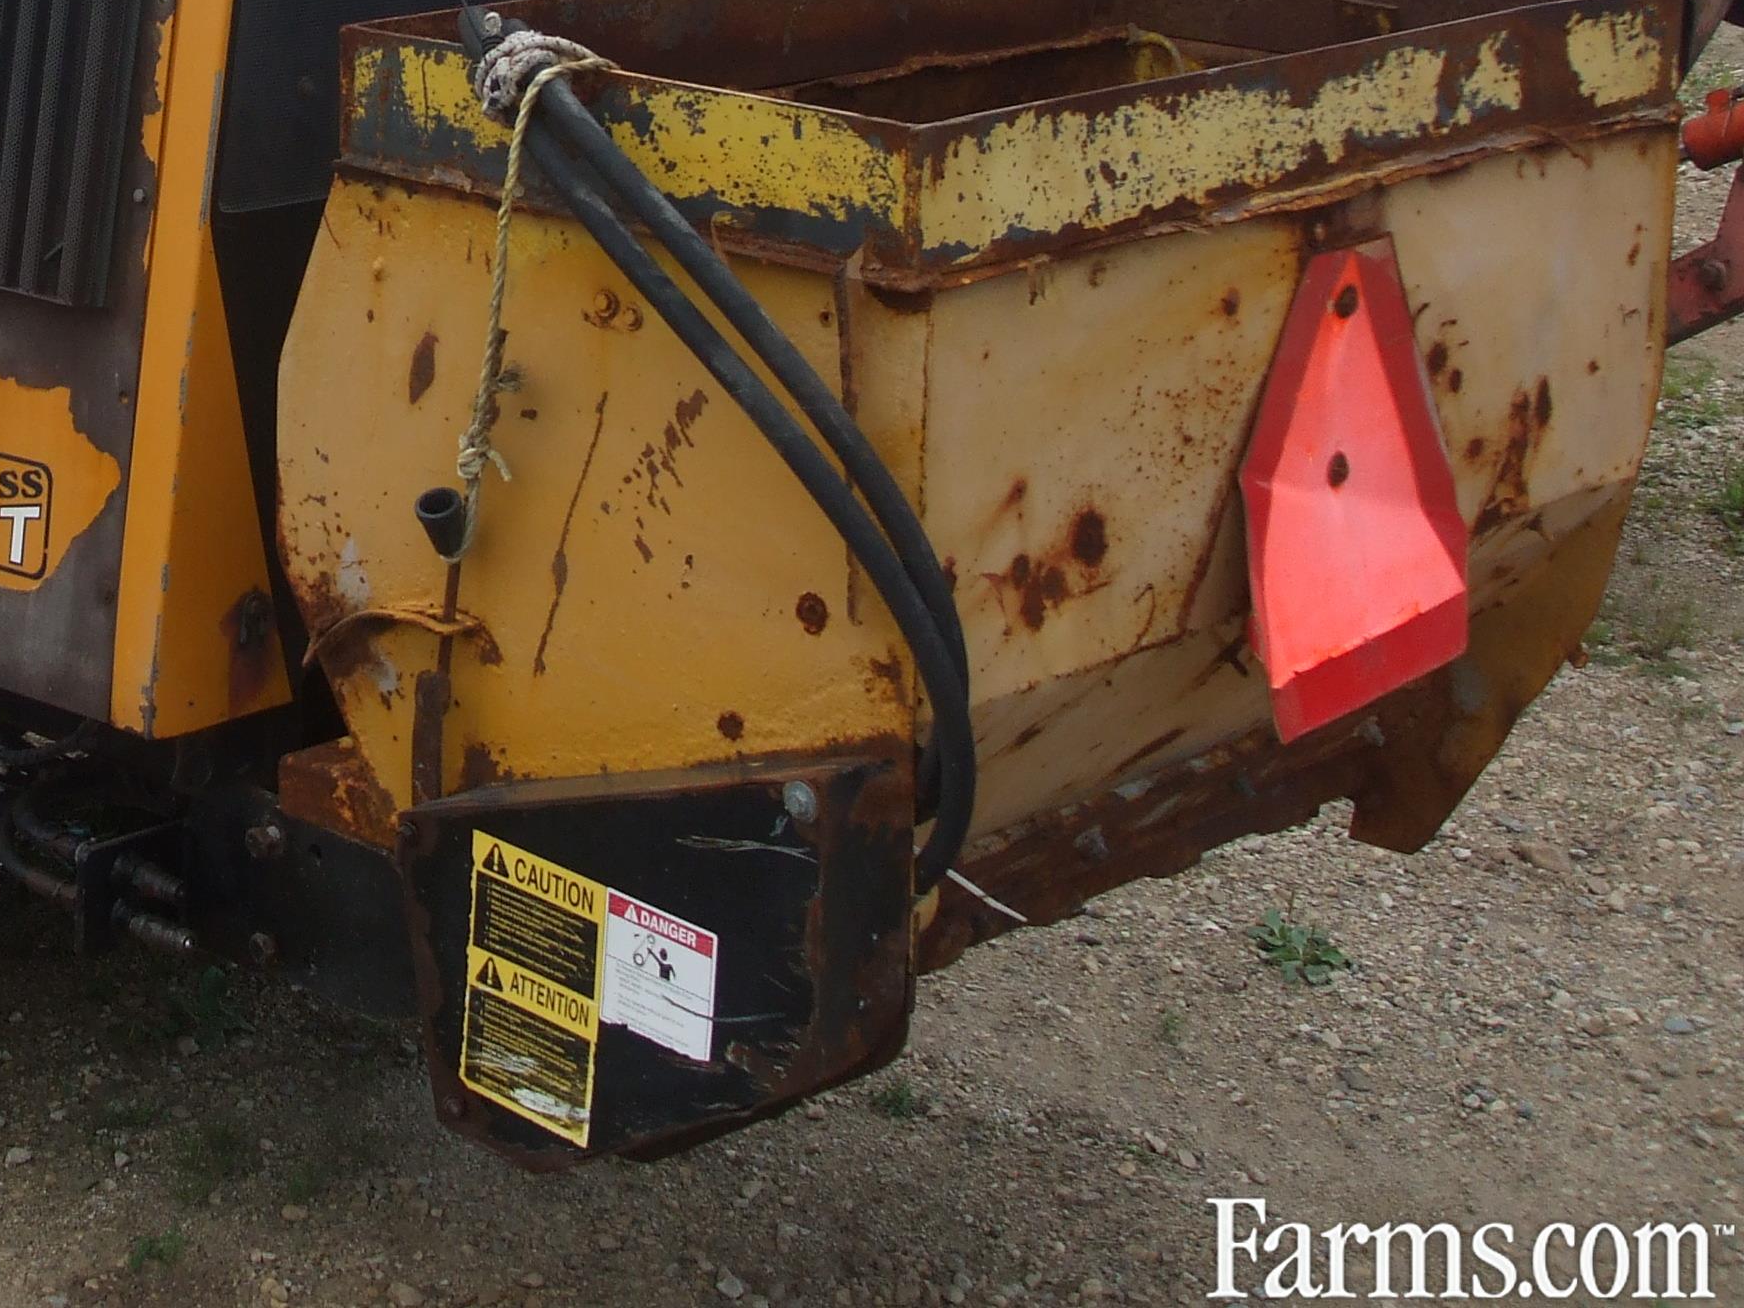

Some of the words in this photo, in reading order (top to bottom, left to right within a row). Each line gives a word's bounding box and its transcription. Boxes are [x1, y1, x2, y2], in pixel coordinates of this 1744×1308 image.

[514, 858, 594, 914] CAUTION
[640, 910, 697, 948] DANGER
[509, 971, 588, 1028] ATTENTION
